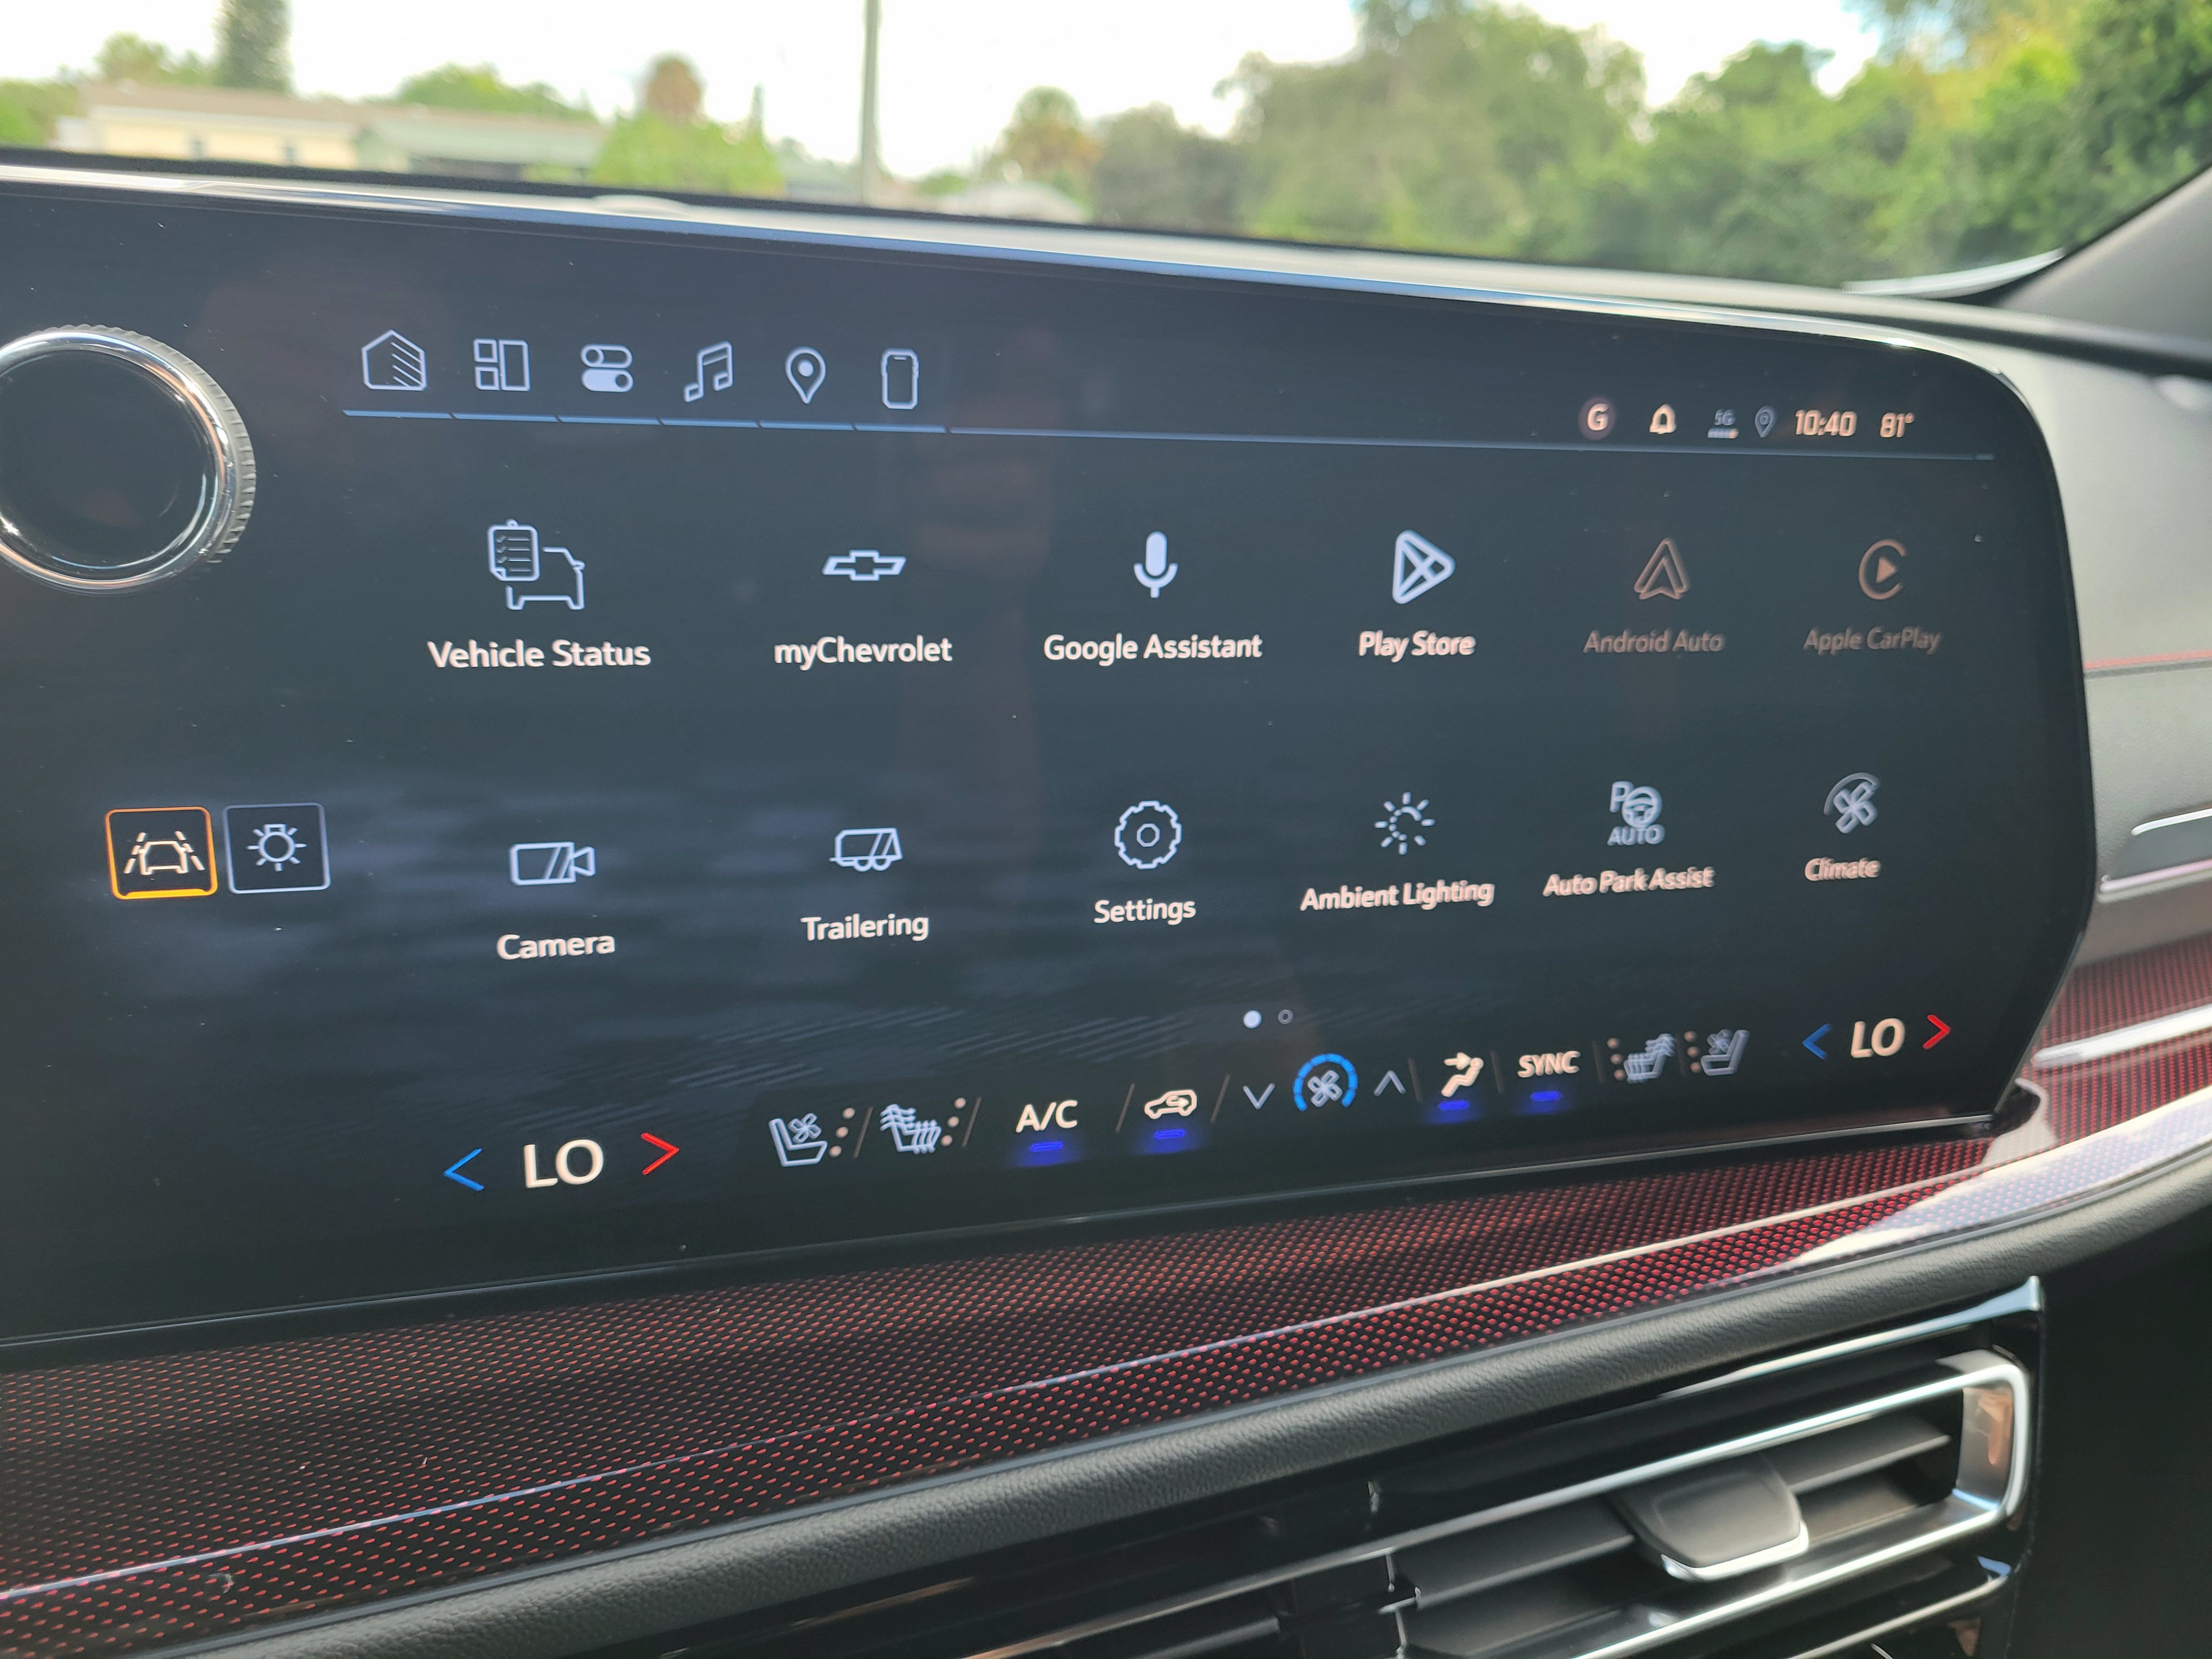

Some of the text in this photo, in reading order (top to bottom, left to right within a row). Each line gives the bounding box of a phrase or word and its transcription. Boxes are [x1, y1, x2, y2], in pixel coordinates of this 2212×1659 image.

[1587, 403, 1609, 431] G
[1713, 408, 1736, 426] 5G
[1795, 409, 1857, 437] 10:40
[427, 639, 652, 668] Vehicle Status
[775, 635, 953, 671] myChevrolet
[1044, 633, 1263, 667] Google Assistant
[1359, 630, 1476, 663] Play Store
[1583, 629, 1726, 653] Android Auto
[1803, 627, 1942, 654] Apple CarPlay
[1607, 825, 1664, 845] AUTO
[1543, 866, 1715, 896] Auto Park Assist
[1804, 857, 1881, 881] Climate
[1299, 879, 1496, 911] Ambient Lighting
[1094, 898, 1197, 926] Settings
[800, 913, 930, 941] Trailering
[496, 934, 616, 960] Camera
[1850, 1018, 1906, 1058] LO
[1517, 1050, 1581, 1077] SYNC
[1015, 1099, 1079, 1133] A/C
[524, 1138, 605, 1188] LO
